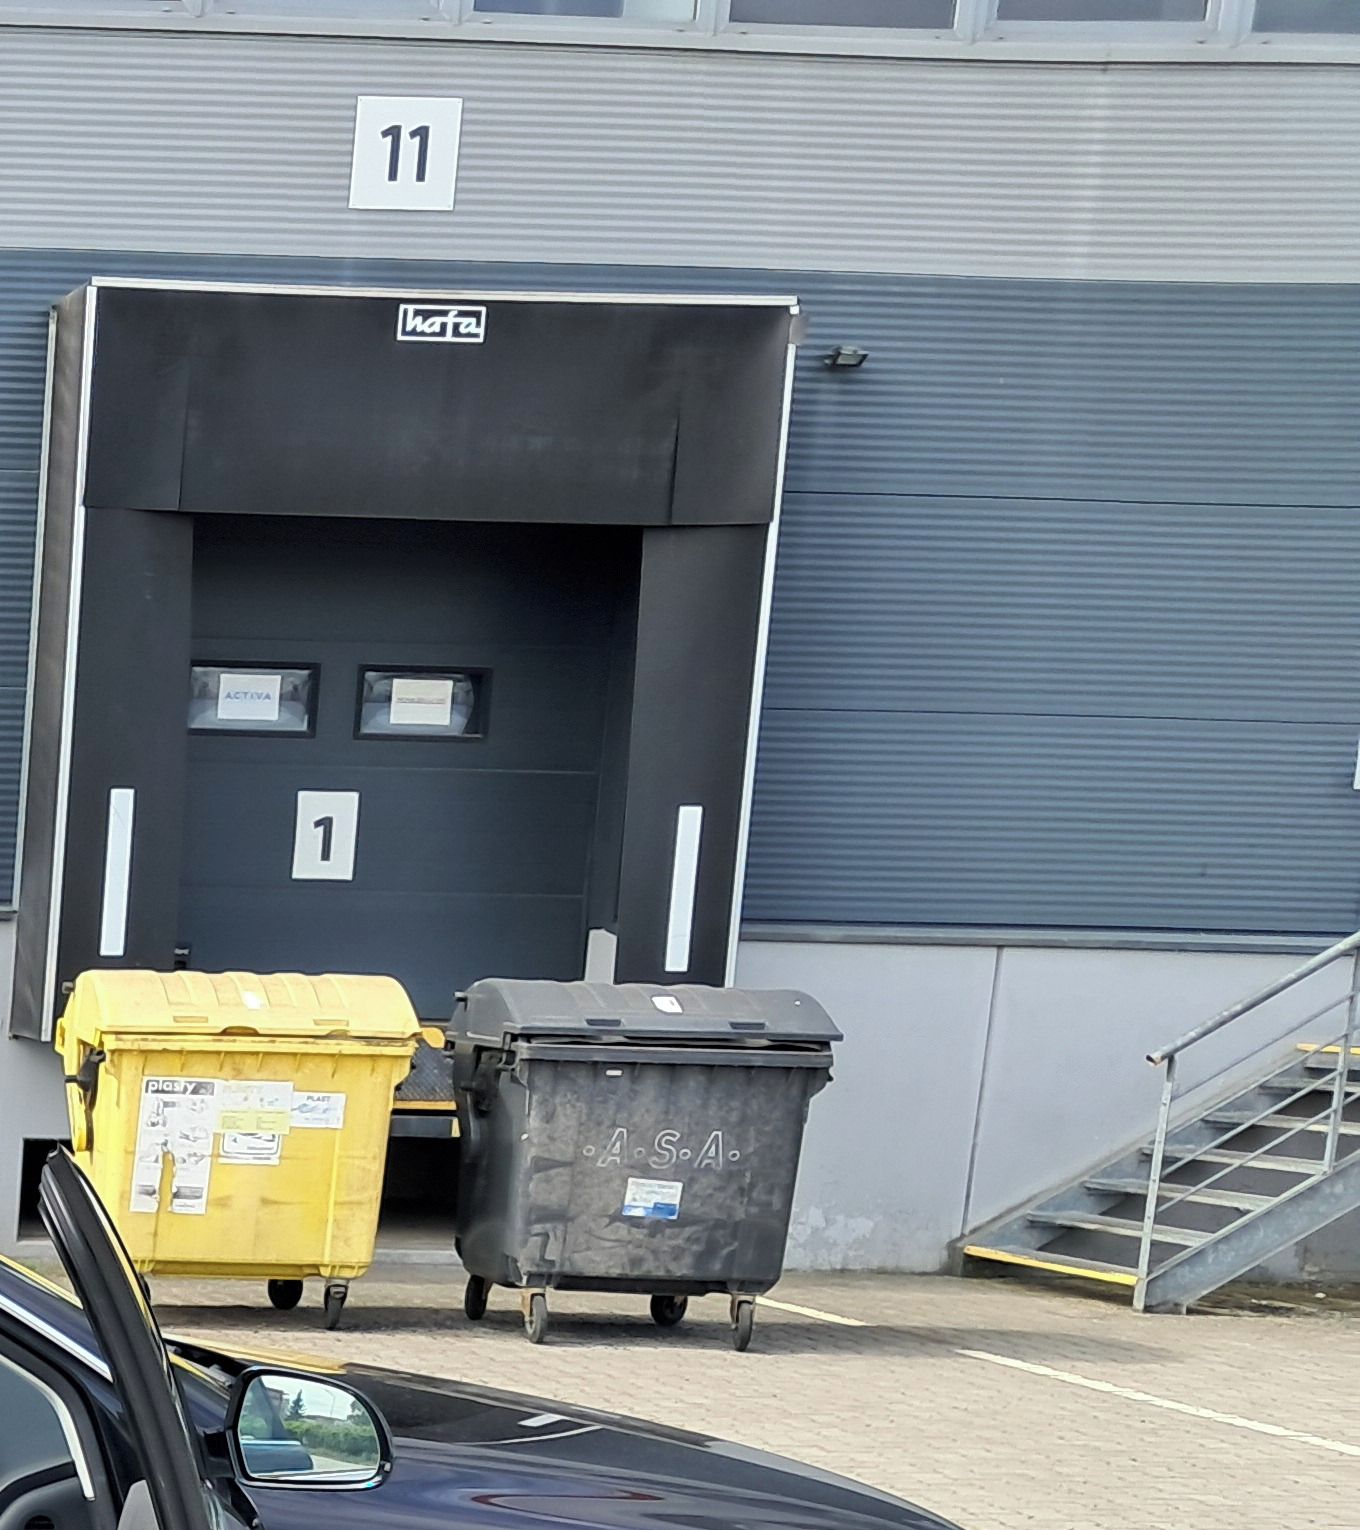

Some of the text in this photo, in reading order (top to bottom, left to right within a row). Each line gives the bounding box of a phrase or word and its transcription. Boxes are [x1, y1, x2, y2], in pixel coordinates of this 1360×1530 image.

[379, 123, 431, 184] 11
[405, 307, 483, 340] hafa
[223, 690, 272, 701] ACTIVA
[312, 815, 335, 862] 1
